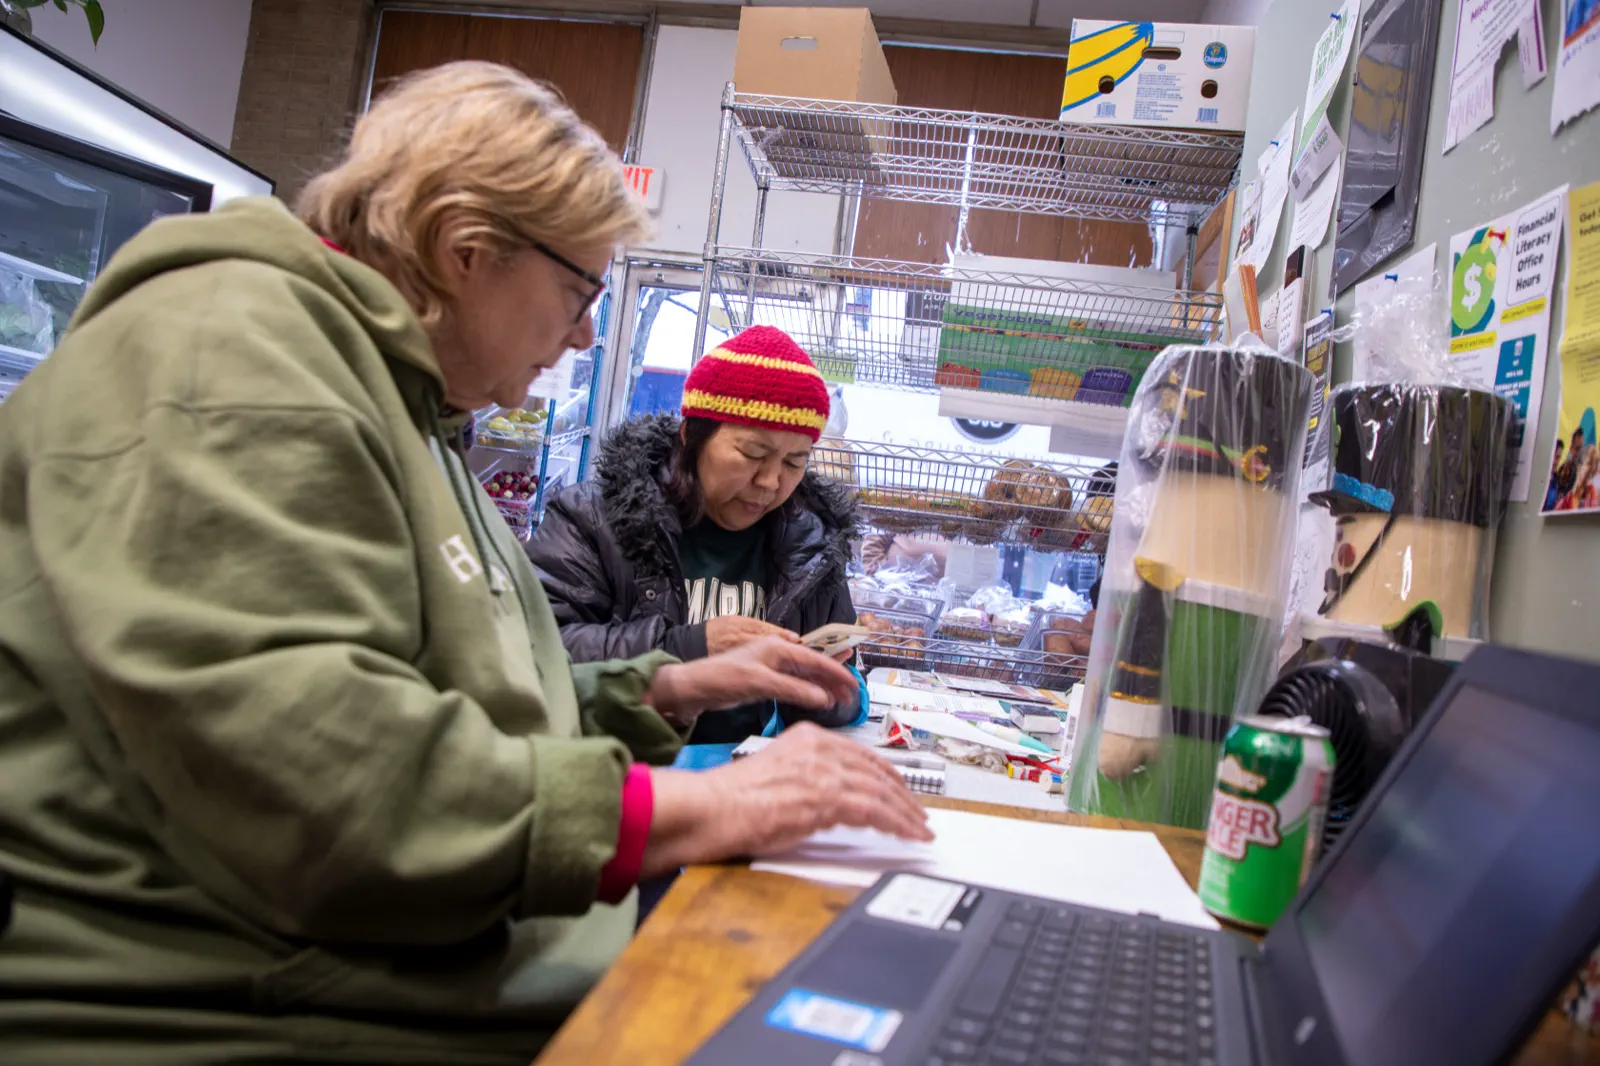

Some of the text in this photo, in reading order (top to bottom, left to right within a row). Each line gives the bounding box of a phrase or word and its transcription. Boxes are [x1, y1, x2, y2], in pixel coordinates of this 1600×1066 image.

[1517, 207, 1557, 238] Financial
[1515, 230, 1552, 256] Literacy
[1517, 253, 1544, 273] Office
[1515, 273, 1541, 292] Hours
